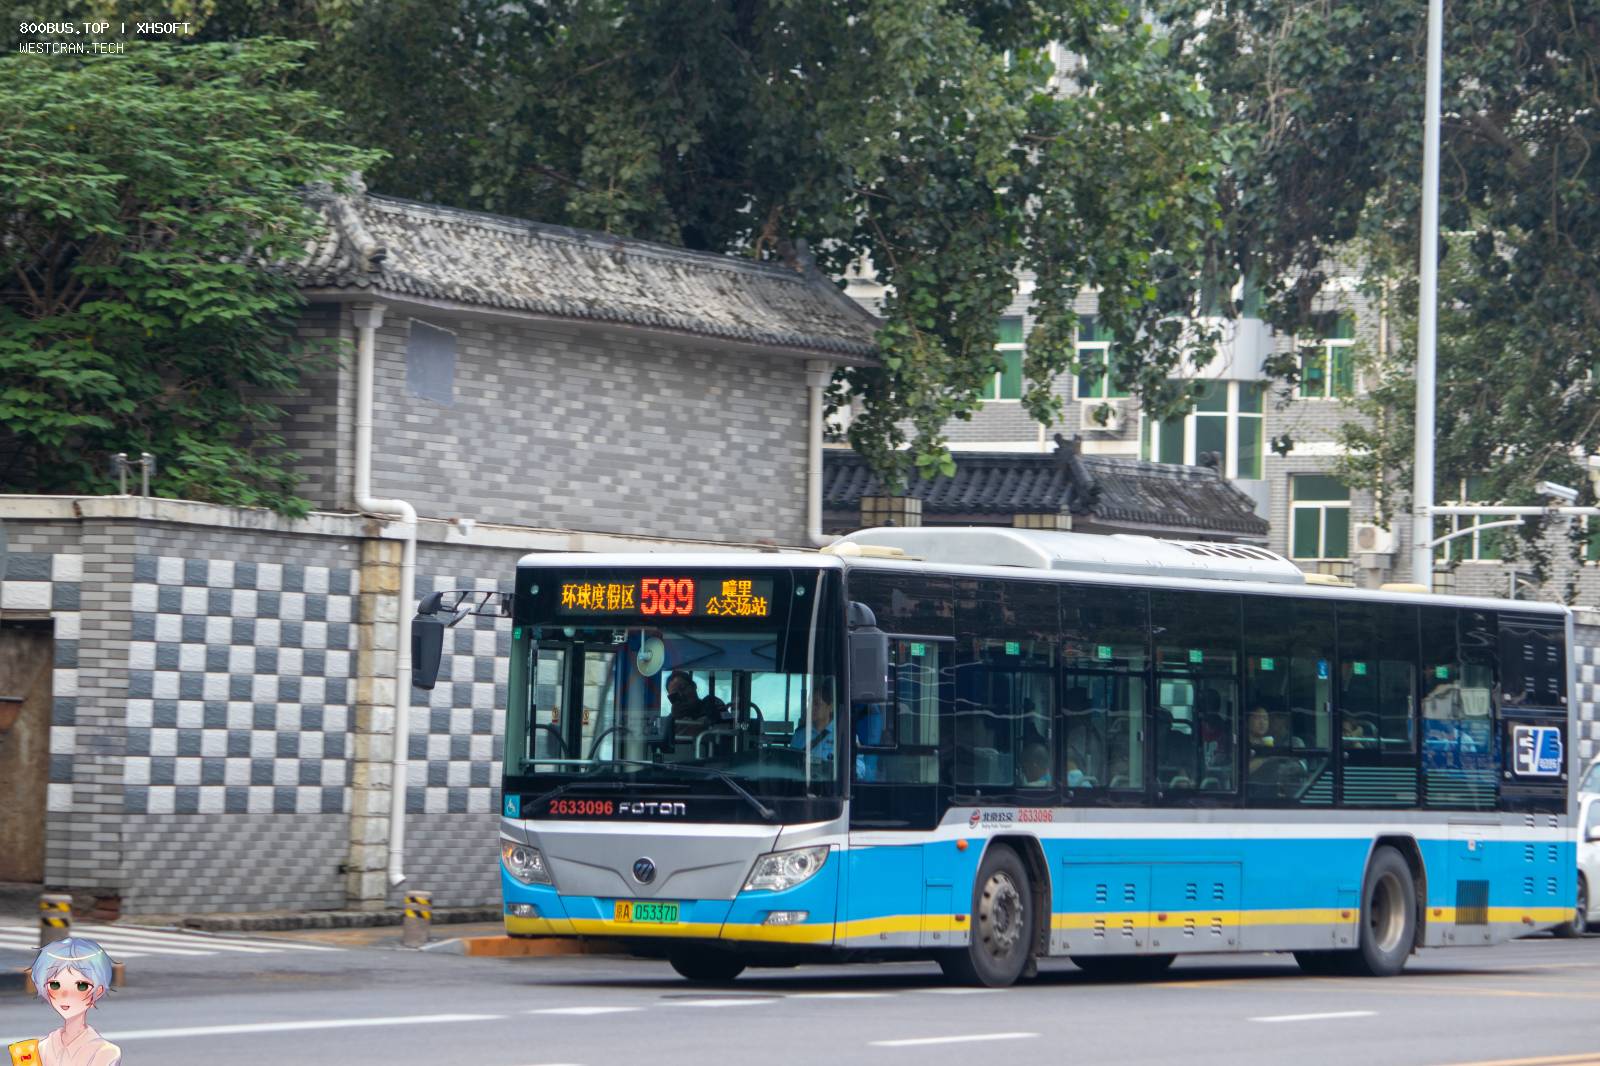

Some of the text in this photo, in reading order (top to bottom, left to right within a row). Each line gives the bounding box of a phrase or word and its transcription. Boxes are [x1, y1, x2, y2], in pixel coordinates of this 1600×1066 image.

[561, 578, 694, 615] 环球度假区 589
[705, 596, 768, 616] 公交场站
[550, 800, 613, 815] 2633096
[619, 802, 686, 815] FOTON
[1018, 808, 1053, 823] 2633096
[635, 904, 677, 921] 05337D
